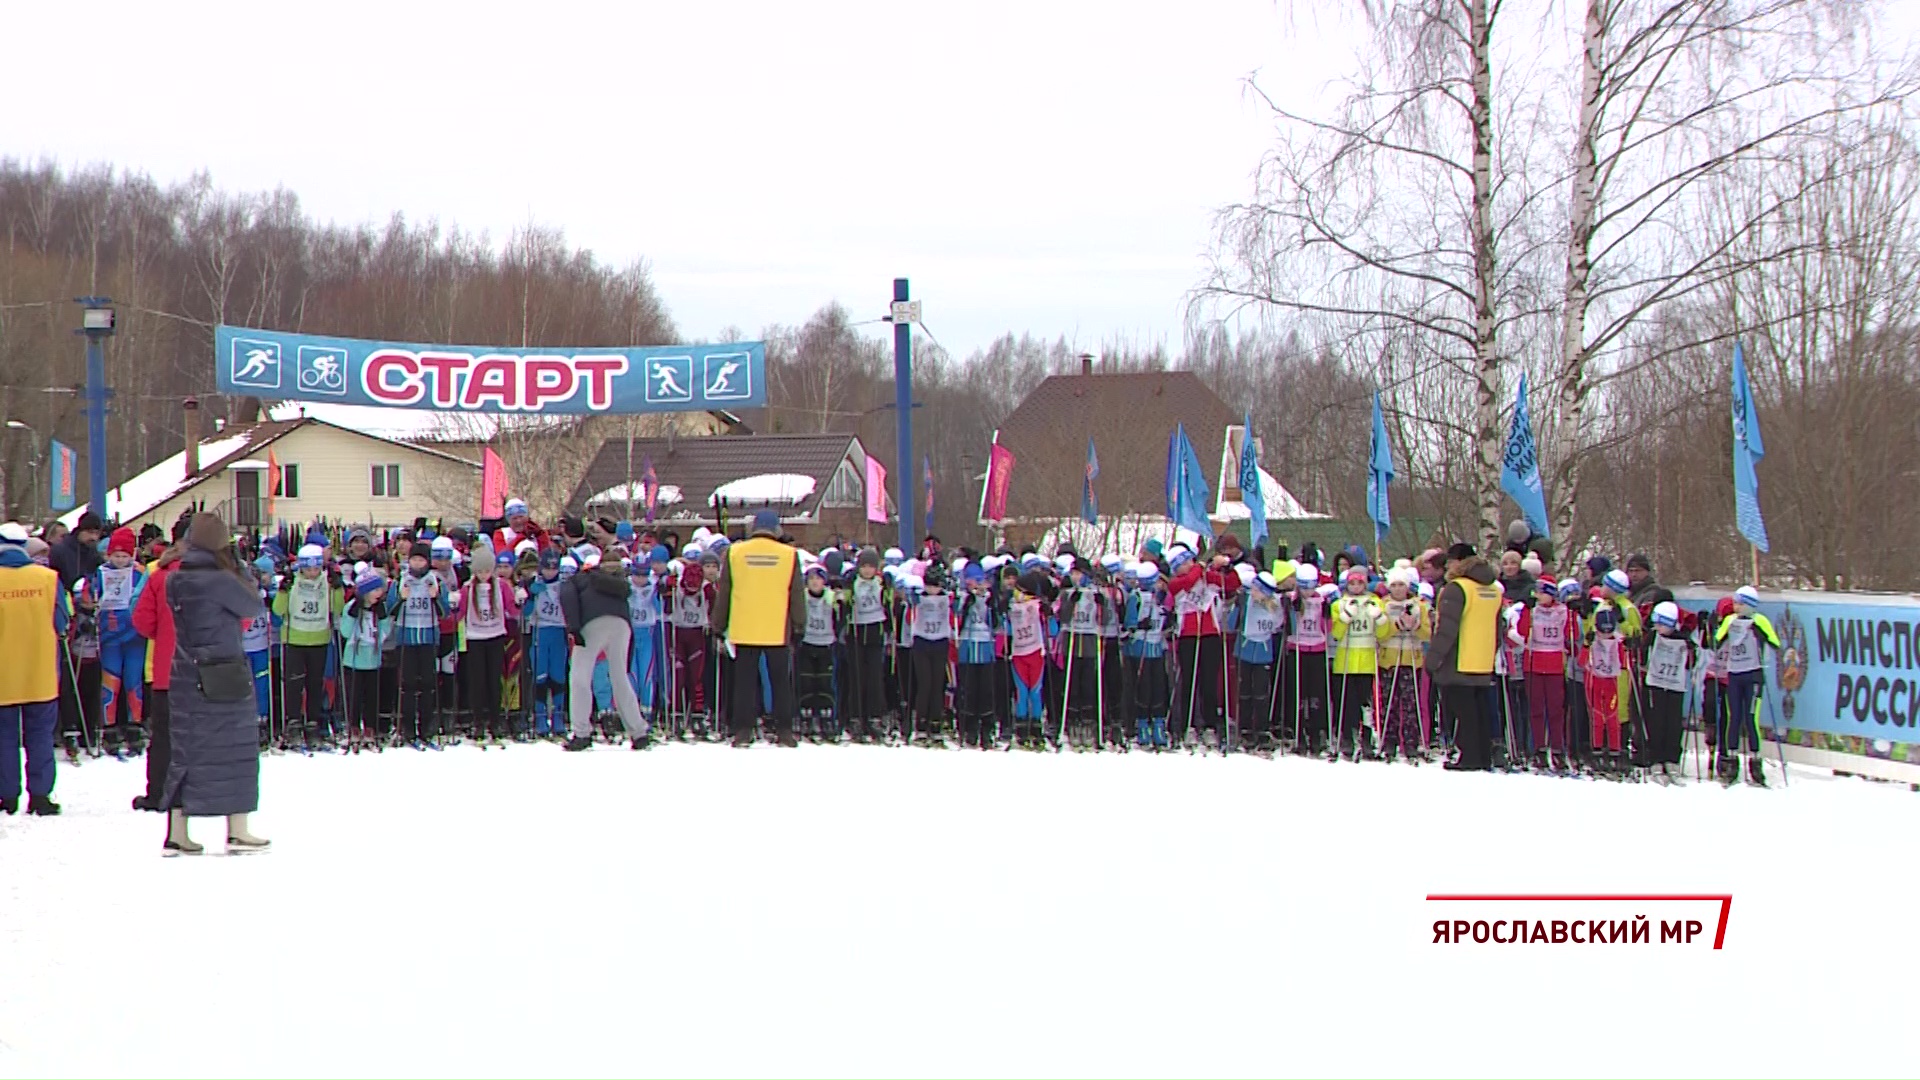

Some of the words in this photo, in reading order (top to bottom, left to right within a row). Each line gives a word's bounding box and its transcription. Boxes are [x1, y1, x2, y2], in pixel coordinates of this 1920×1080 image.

[363, 351, 627, 409] СТАРТ
[409, 597, 429, 610] 336
[541, 601, 559, 617] 251
[683, 611, 700, 624] 102
[1257, 619, 1274, 632] 160
[1303, 619, 1317, 631] 121
[1351, 619, 1368, 632] 124
[1543, 627, 1559, 638] 153
